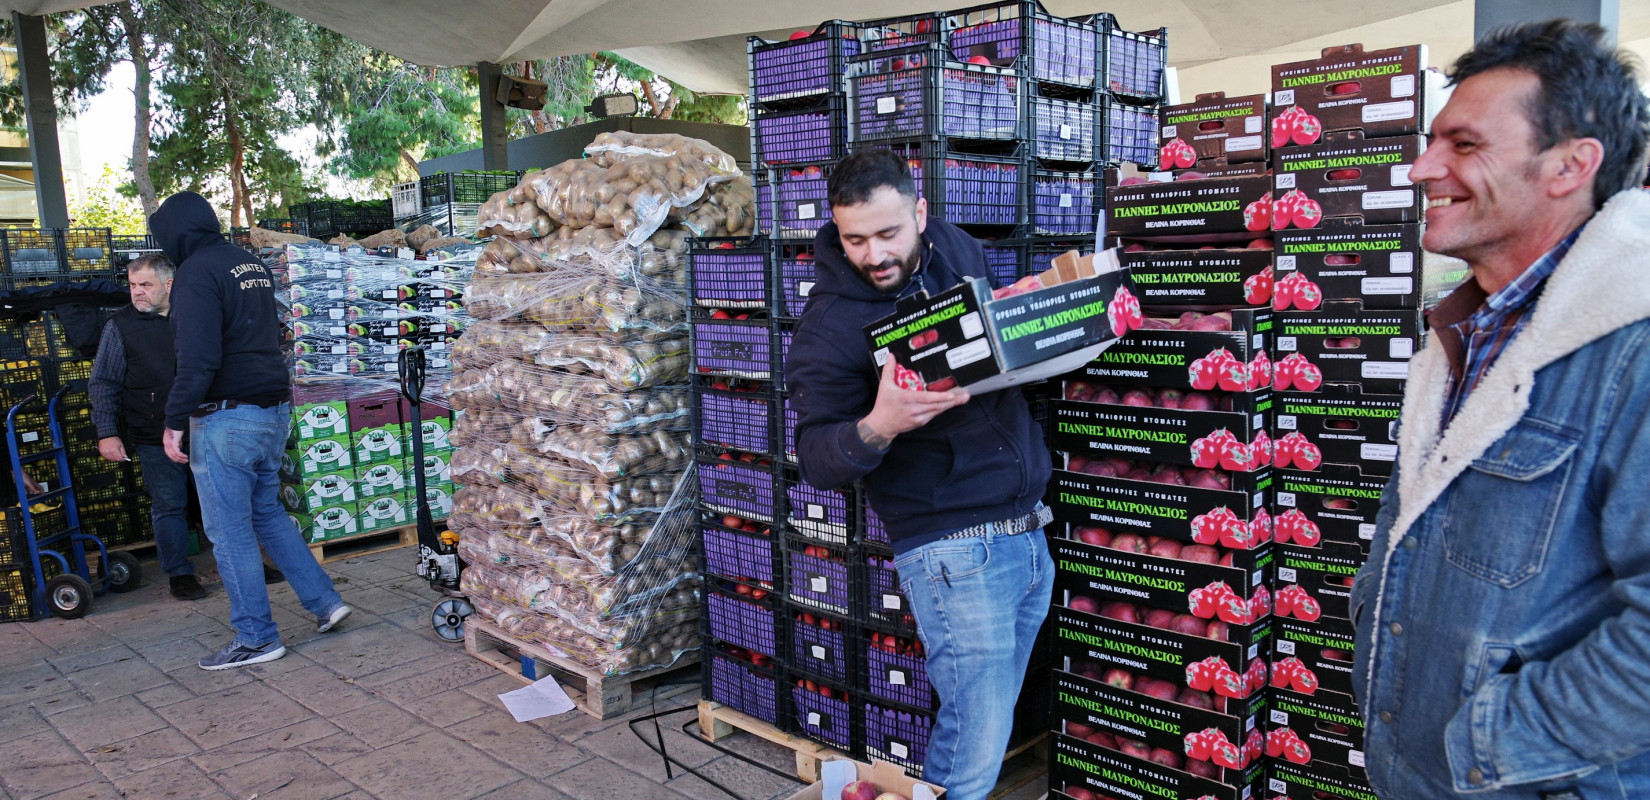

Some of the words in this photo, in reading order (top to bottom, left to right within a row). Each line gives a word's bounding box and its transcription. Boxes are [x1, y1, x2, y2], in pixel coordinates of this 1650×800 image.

[1282, 74, 1325, 87] ΓΙΑΝΝΗΣ
[1327, 64, 1402, 82] ΜΑΥΡΟΝΑΣΙΟΣ
[1168, 114, 1199, 124] ΓΙΑΝΝΗΣ
[1199, 108, 1252, 120] ΜΑΥΡΟΝΑΣΙΟΣ
[1284, 159, 1326, 171] ΓΙΑΝΝΗΣ
[1327, 153, 1402, 167] ΜΑΥΡΟΝΑΣΙΟΣ
[1198, 187, 1239, 195] ΝΤΟΜΑΤΕΣ
[1114, 206, 1159, 218] ΓΙΑΝΝΗΣ
[1161, 200, 1240, 214] ΜΑΥΡΟΝΑΣΙΟΣ
[1284, 243, 1326, 253] ΓΙΑΝΝΗΣ
[1327, 240, 1401, 251] ΜΑΥΡΟΝΑΣΙΟΣ
[1131, 274, 1160, 283] ΝΝΗΣ
[1162, 272, 1240, 283] ΜΑΥΡΟΝΑΣΙΟΣ
[875, 326, 908, 347] ΓΙΑΝΝΗΣ
[907, 302, 966, 334] ΜΑΥΡΟΝΑΣΙΟΣ
[1001, 318, 1044, 342] ΓΙΑΝΝΗΣ
[1042, 301, 1105, 329] ΜΑΥΡΟΝΑΣΙΟΣ
[1285, 326, 1326, 334] ΓΙΑΝΝΗΣ
[1328, 326, 1401, 335] ΜΑΥΡΟΝΑΣΙΟΣ
[1104, 353, 1185, 365] ΜΑΥΡΟΝΑΣΙΟΣ
[1096, 413, 1136, 422] ΥΠΑΙΘΡΙΕΣ
[1144, 418, 1186, 426] ΝΤΟΜΑΤΕΣ
[1286, 405, 1326, 414] ΓΙΑΝΝΗΣ
[1328, 407, 1399, 418] ΜΑΥΡΟΝΑΣΙΟΣ
[1059, 423, 1103, 436] ΓΙΑΝΝΗΣ
[1106, 427, 1187, 444] ΜΑΥΡΟΝΑΣΙΟΣ
[1090, 442, 1113, 450] ΒΕΛΙΝΑ
[1114, 444, 1151, 454] ΚΟΡΙΝΘΙΑΣ
[1060, 480, 1089, 489] ΟΡΕΙΝΕΣ
[1097, 486, 1137, 496] ΥΠΑΙΘΡΙΕΣ
[1145, 492, 1187, 502] ΝΤΟΜΑΤΕΣ
[1285, 483, 1324, 494] ΓΙΑΝΝΗΣ
[1060, 493, 1104, 508] ΓΙΑΝΝΗΣ
[1107, 500, 1187, 519] ΜΑΥΡΟΝΑΣΙΟΣ
[1091, 513, 1114, 522] ΒΕΛΙΝΑ
[1115, 517, 1151, 528] ΚΟΡΙΝΘΙΑΣ
[1060, 548, 1088, 558] ΟΡΕΙΝΕΣ
[1096, 555, 1135, 567] ΥΠΑΙΘΡΙΕΣ
[1143, 564, 1184, 575] ΝΤΟΜΑΤΕΣ
[1286, 559, 1325, 571] ΓΙΑΝΝΗΣ
[1060, 560, 1103, 577] ΓΙΑΝΝΗΣ
[1106, 569, 1185, 592] ΜΑΥΡΟΝΑΣΙΟΣ
[1090, 582, 1113, 591] ΒΕΛΙΝΑ
[1114, 587, 1150, 598] ΚΟΡΙΝΘΙΑΣ
[1059, 616, 1088, 627] ΟΡΕΙΝΕΣ
[1095, 625, 1134, 638] ΥΠΑΙΘΡΙΕΣ
[1142, 636, 1182, 650] ΝΤΟΜΑΤΕΣ
[1285, 631, 1324, 645] ΓΙΑΝΝΗΣ
[1060, 628, 1102, 646] ΓΙΑΝΝΗΣ
[1105, 639, 1182, 665] ΜΑΥΡΟΝΑΣΙΟΣ
[1089, 651, 1111, 661] ΒΕΛΙΝΑ
[1113, 654, 1147, 669] ΚΟΡΙΝΘΙΑΣ
[1059, 681, 1088, 693] ΟΡΕΙΝΕΣ
[1095, 691, 1133, 708] ΥΠΑΙΘΡΙΕΣ
[1140, 704, 1180, 719] ΝΤΟΜΑΤΕΣ
[1060, 692, 1102, 712] ΓΙΑΝΝΗΣ
[1104, 705, 1180, 735] ΜΑΥΡΟΝΑΣΙΟΣ
[1278, 702, 1316, 717] ΓΙΑΝΝΗΣ
[1319, 711, 1364, 728] ΜΑΥΡΟΝΑ
[1088, 716, 1110, 727] ΒΕΛΙΝΑ
[1112, 723, 1146, 737] ΚΟΡΙΝΘΙΑΣ
[1058, 742, 1086, 756] ΟΡΕΙΝΕΣ
[1094, 754, 1131, 771] ΥΠΑΙΘΡΙΕΣ
[1139, 769, 1178, 787] ΝΤΟΜΑΤΕΣ
[1058, 754, 1100, 775] ΓΙΑΝΝΗΣ
[1102, 768, 1177, 800] ΜΑΥΡΟΝΑΣΙΟΣ
[1277, 771, 1314, 787] ΓΙΑΝΝΗΣ
[1317, 782, 1377, 800] ΜΑΥΡΟΝΑΣΙΟ
